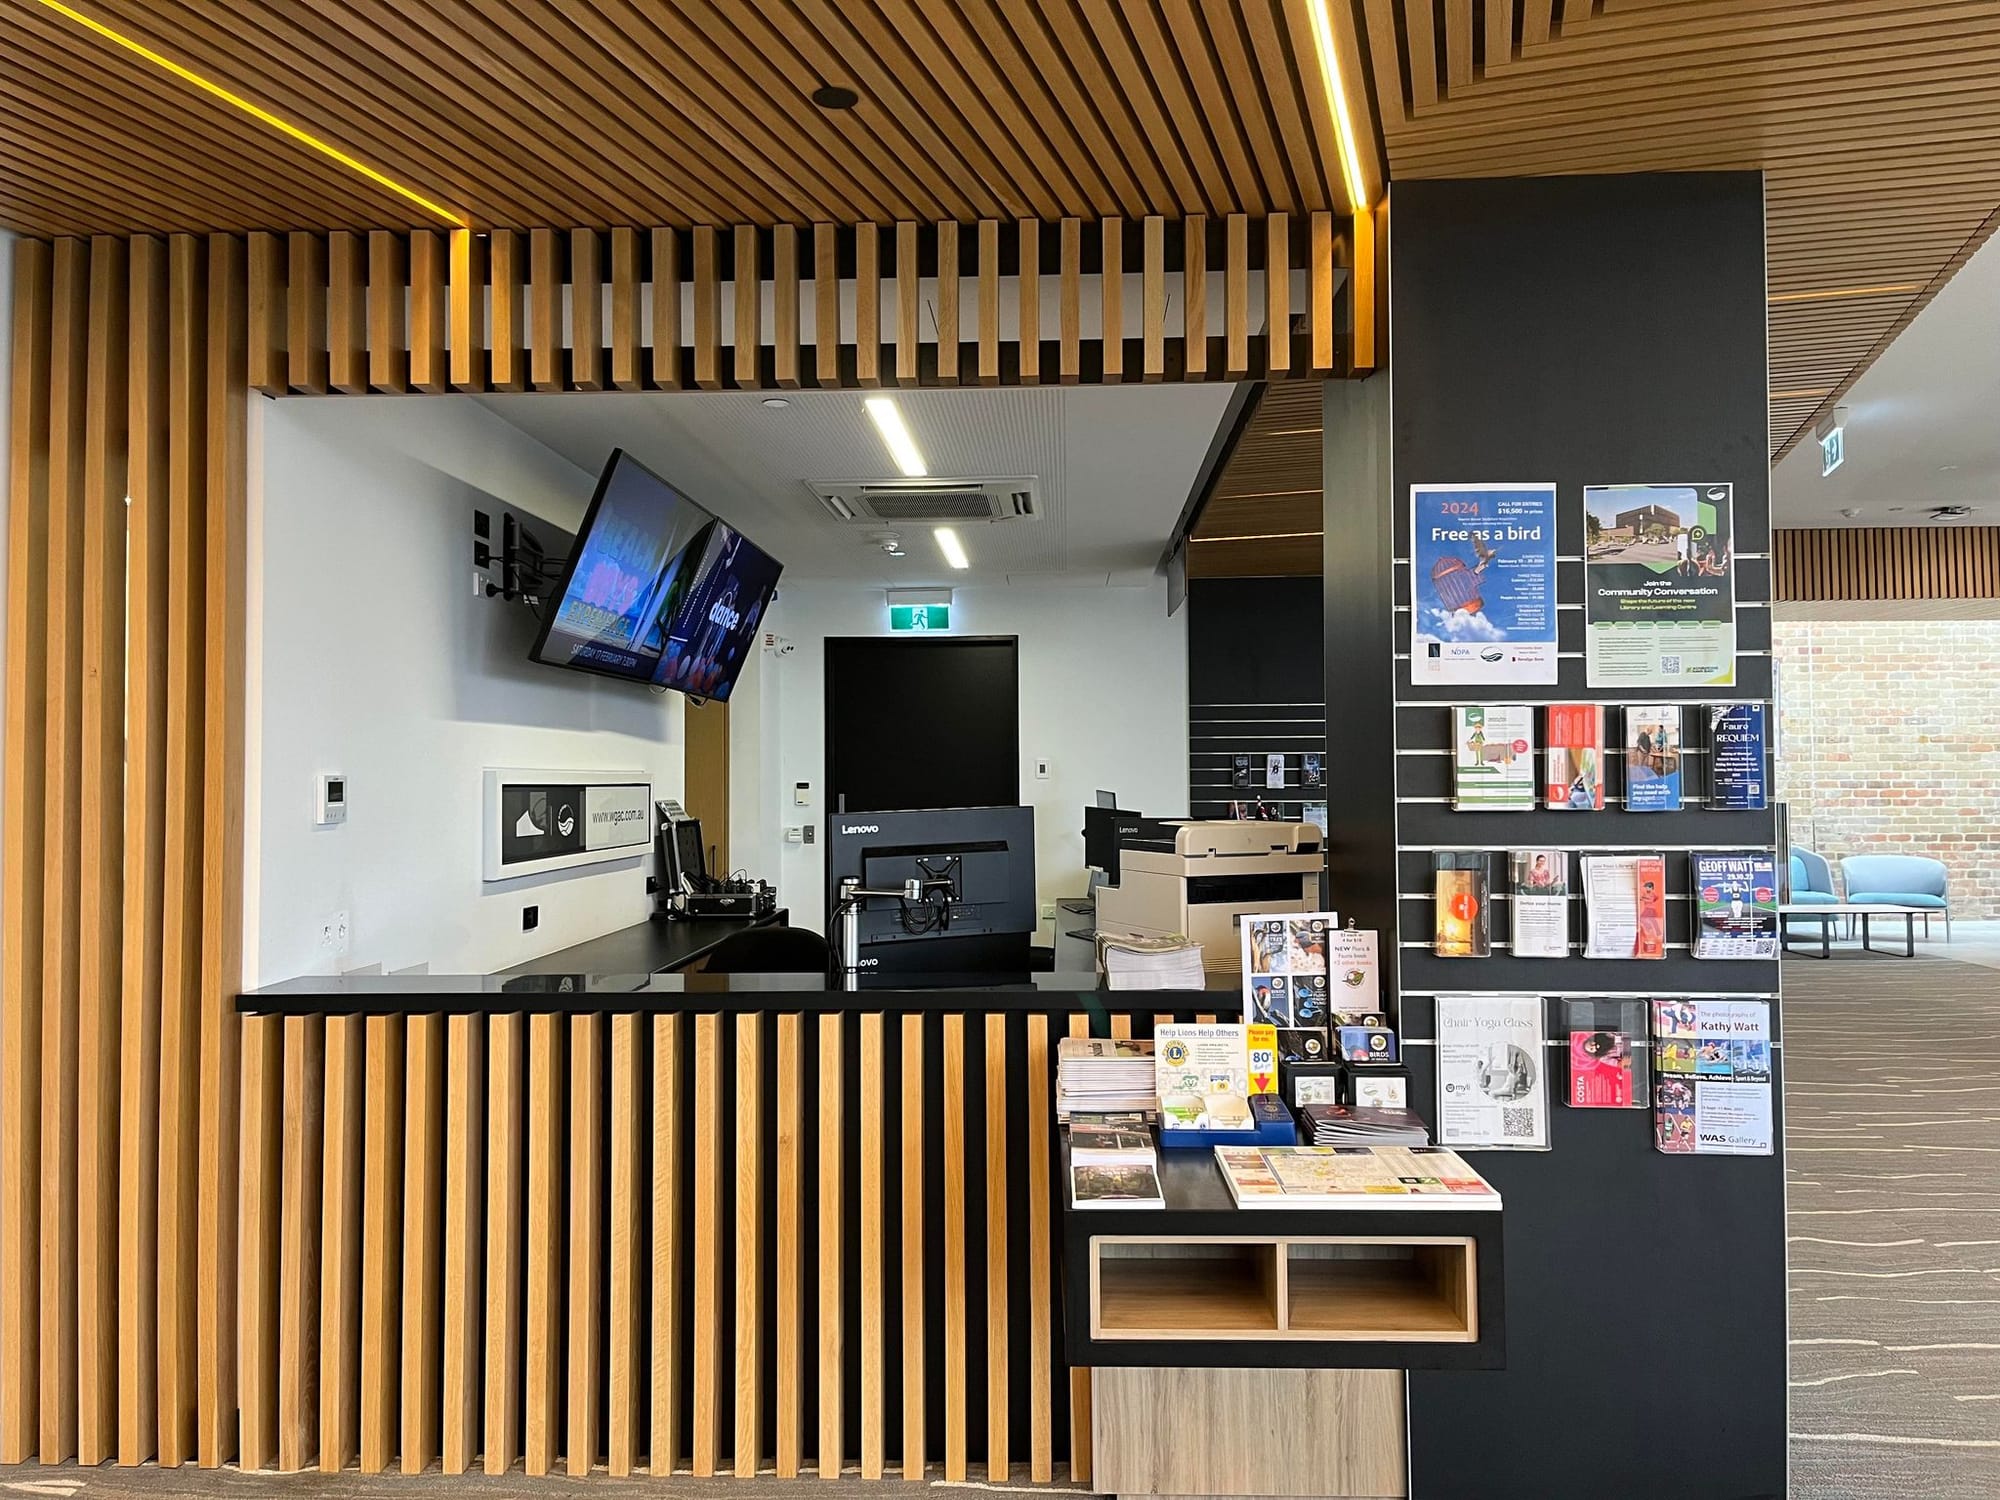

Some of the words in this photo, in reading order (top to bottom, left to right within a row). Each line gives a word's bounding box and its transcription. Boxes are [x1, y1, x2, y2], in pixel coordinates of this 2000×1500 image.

[1441, 502, 1479, 516] 2024
[1432, 528, 1465, 540] Free
[1472, 530, 1490, 540] as
[1494, 530, 1504, 540] a
[1508, 526, 1540, 540] bird
[1598, 588, 1652, 598] Community
[1654, 588, 1718, 596] Conversation
[565, 599, 631, 638] EXPERIENCE
[708, 598, 740, 631] dance
[1716, 734, 1760, 742] REQUIEM
[592, 810, 644, 826] www.wgac.com.au
[842, 824, 879, 834] Lenovo
[1699, 860, 1728, 872] GEOFF
[1728, 860, 1754, 872] WATT
[858, 958, 878, 967] ovo
[1443, 1018, 1472, 1028] Chair
[1474, 1017, 1501, 1030] Yoga
[1504, 1017, 1534, 1028] Class
[1701, 1022, 1732, 1032] Kathy
[1734, 1022, 1760, 1032] Watt
[1160, 1028, 1176, 1038] Help
[1178, 1028, 1197, 1036] Lions
[1198, 1029, 1214, 1038] Help
[1700, 1134, 1726, 1142] WAS
[1728, 1136, 1757, 1145] Gallery
